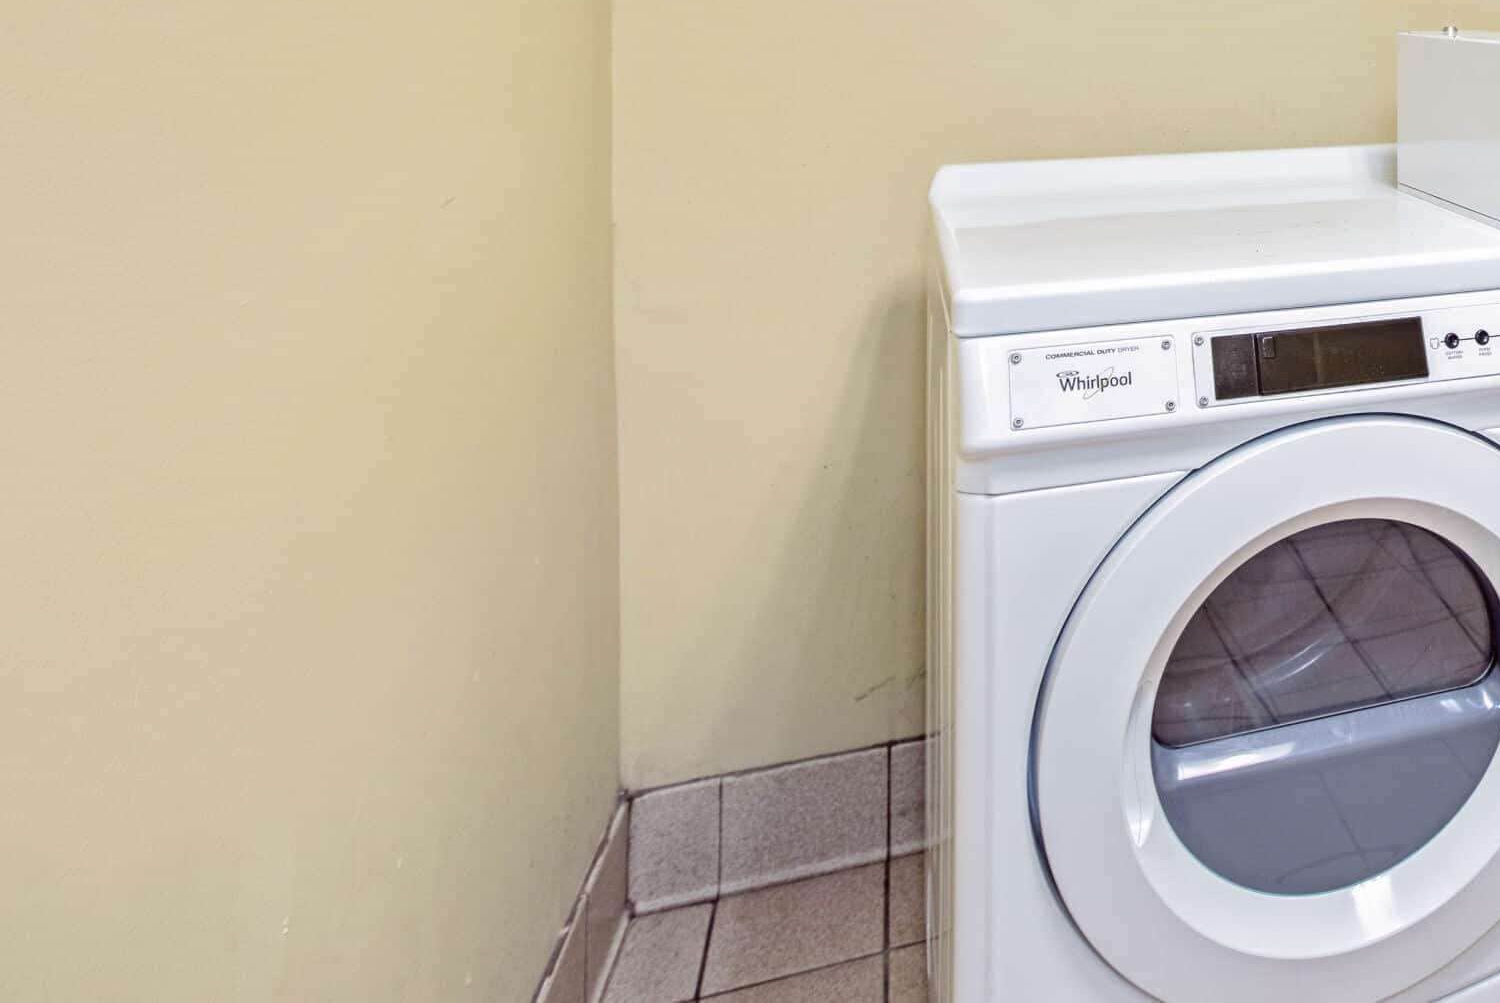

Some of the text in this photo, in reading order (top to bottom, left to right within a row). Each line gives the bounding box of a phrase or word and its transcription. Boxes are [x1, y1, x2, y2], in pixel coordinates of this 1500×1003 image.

[1045, 349, 1095, 360] COMMERCIAL
[1096, 347, 1116, 355] DUTY
[1058, 371, 1132, 392] Whirlpool
